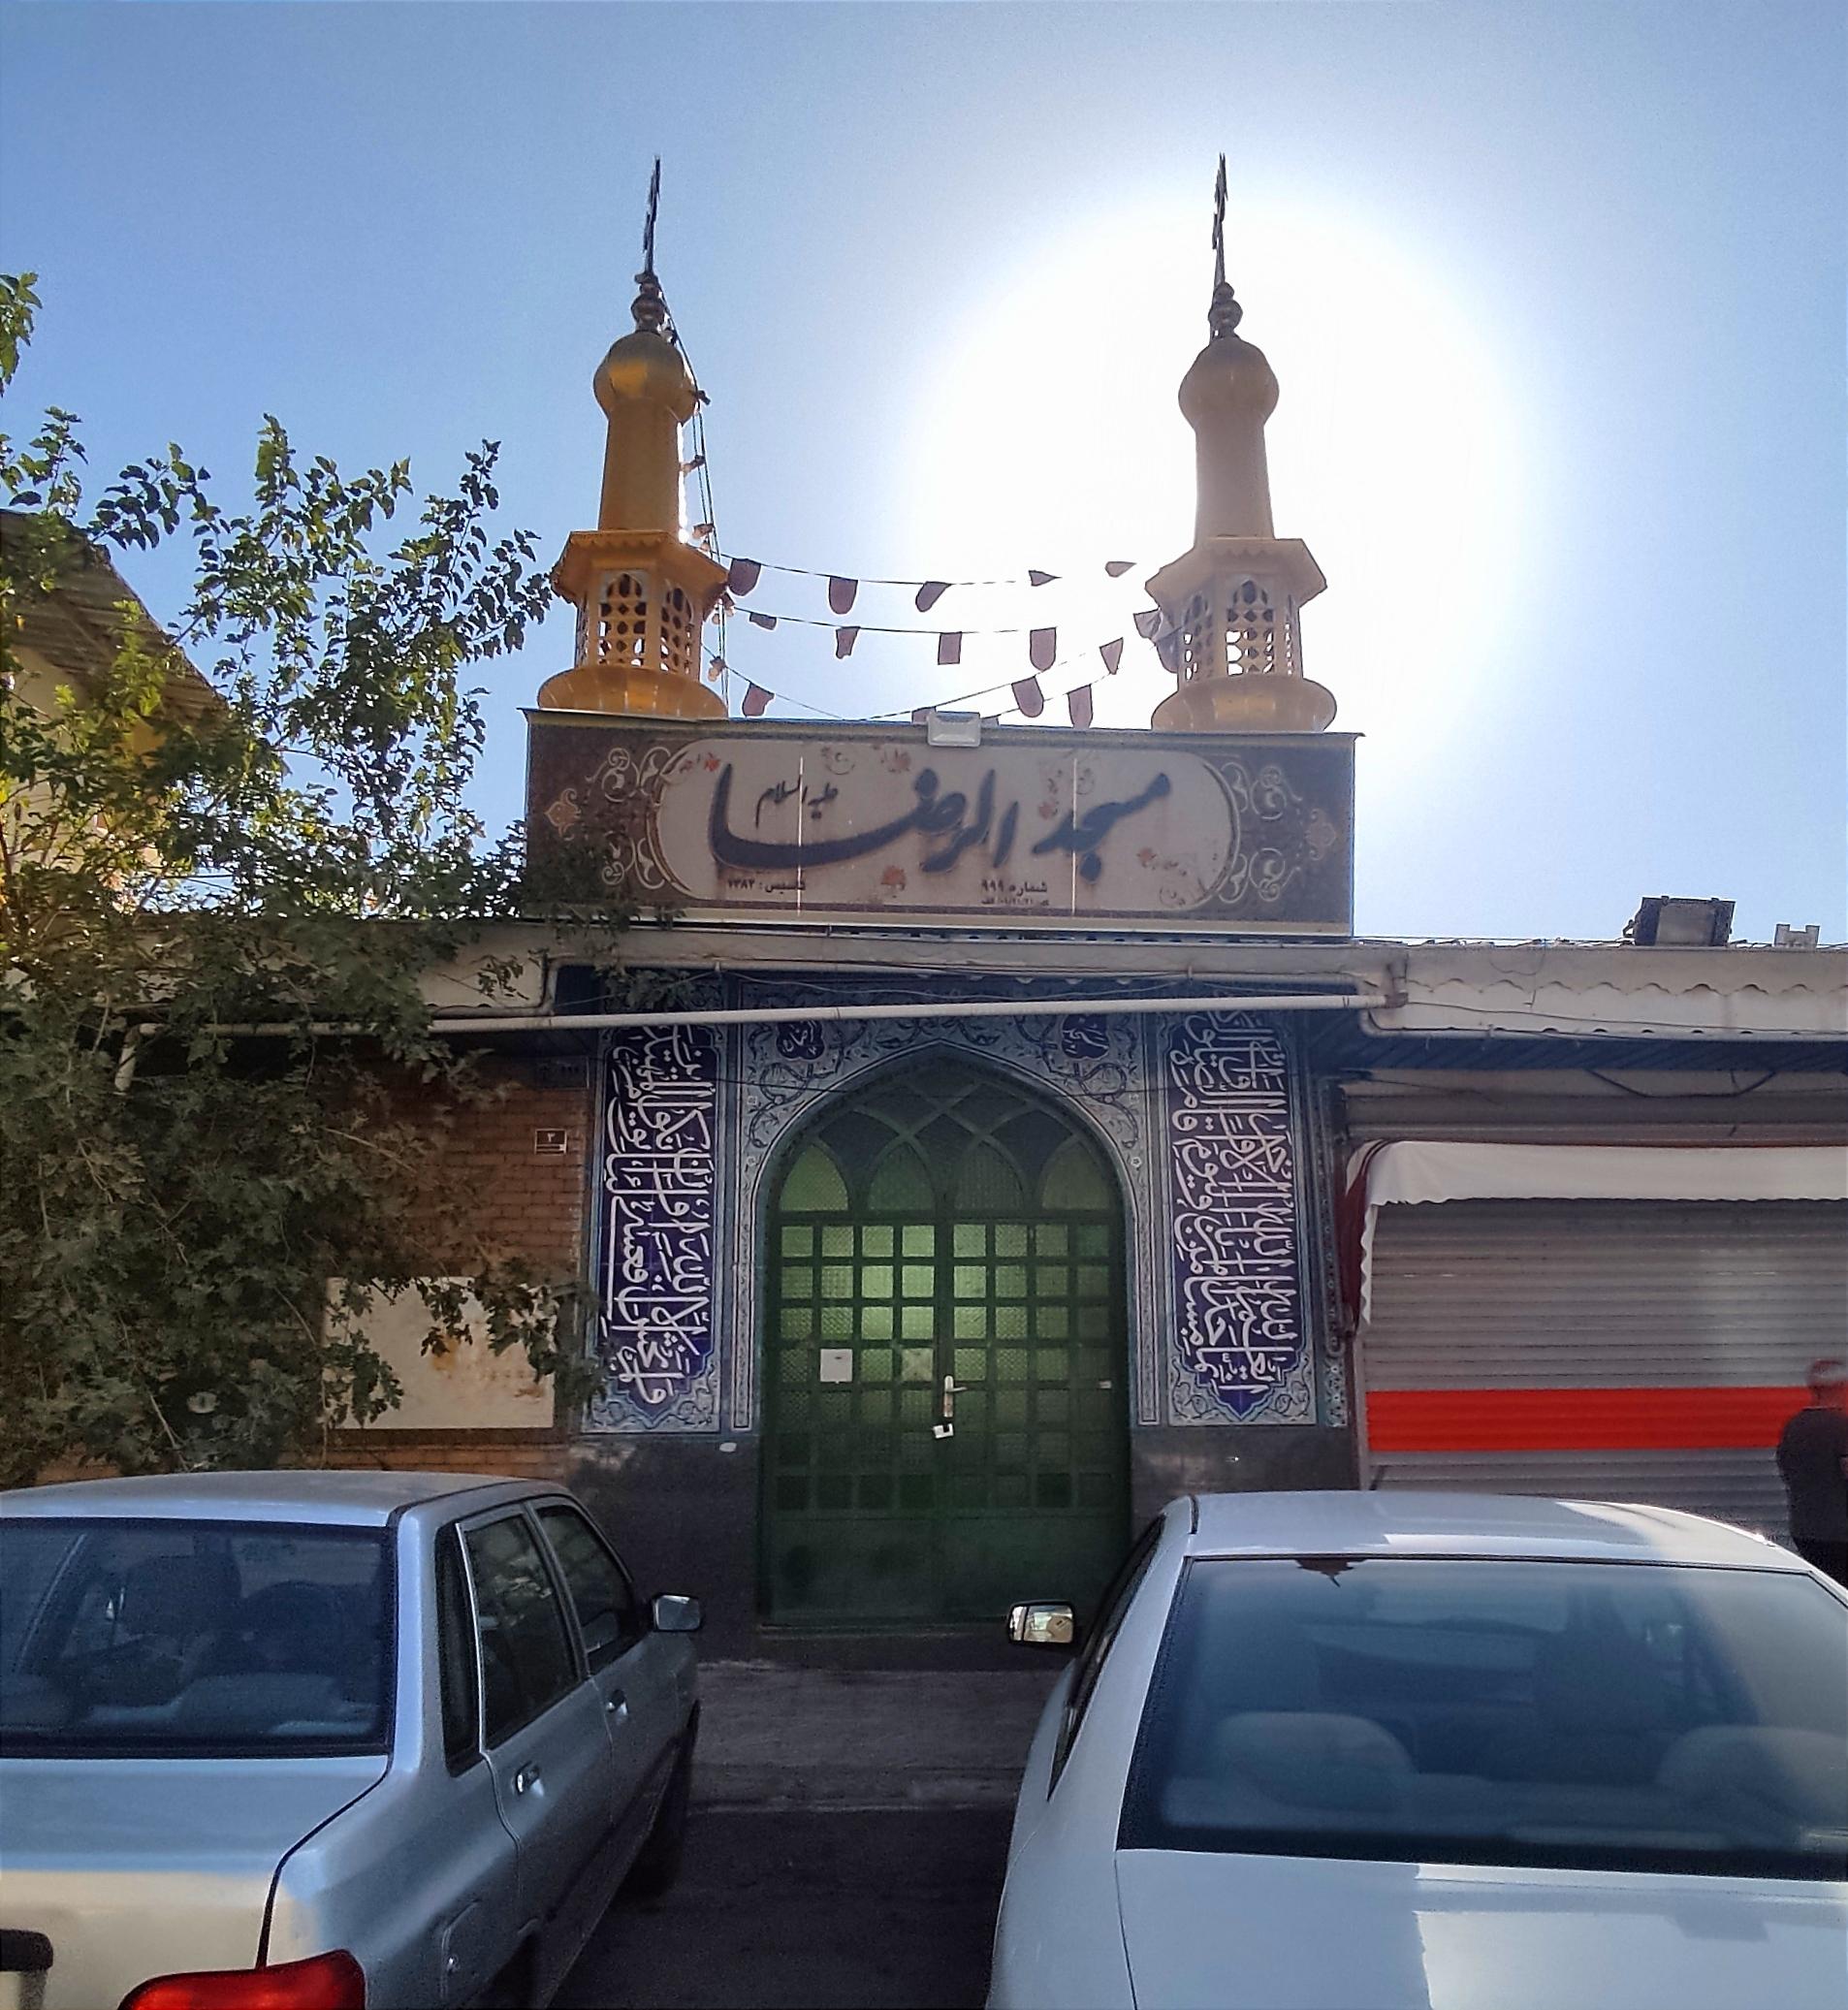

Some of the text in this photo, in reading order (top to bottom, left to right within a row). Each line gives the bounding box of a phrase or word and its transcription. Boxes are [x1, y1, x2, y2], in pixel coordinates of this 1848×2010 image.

[708, 762, 1171, 883] مسجد الرضا
[1008, 880, 1048, 897] شماره
